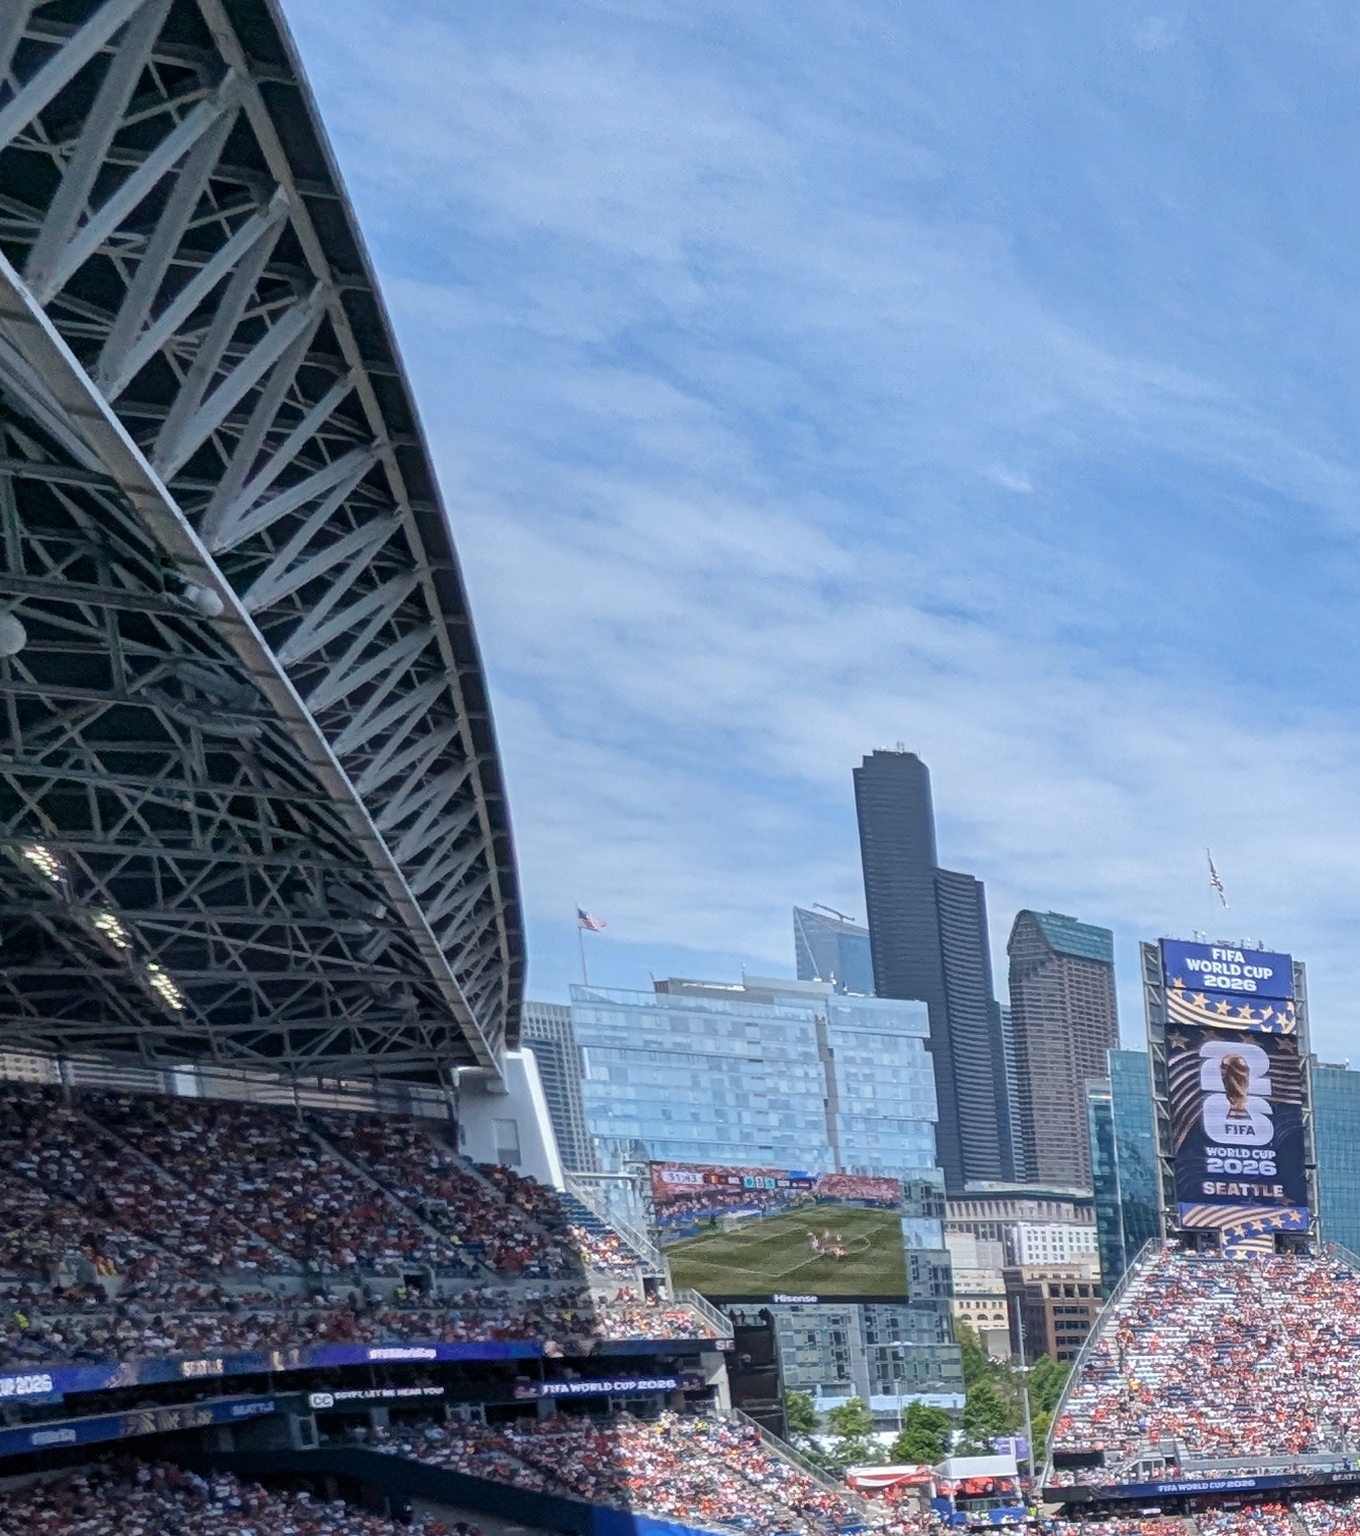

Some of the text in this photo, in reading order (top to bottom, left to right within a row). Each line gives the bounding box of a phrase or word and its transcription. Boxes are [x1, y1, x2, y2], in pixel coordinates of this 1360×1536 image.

[1212, 948, 1245, 964] FIFA
[1186, 958, 1273, 979] WORLD CUP
[1204, 974, 1257, 991] 2026
[1225, 1124, 1256, 1136] FIFA
[1205, 1146, 1276, 1159] WORLD CUP
[1206, 1158, 1277, 1176] 2026
[1203, 1181, 1284, 1197] SEATTLE
[774, 1293, 818, 1303] Hisense
[542, 1379, 676, 1394] FIFA WORLD CUP 2026
[1158, 1479, 1256, 1493] FIFA WORLD CUP 2026
